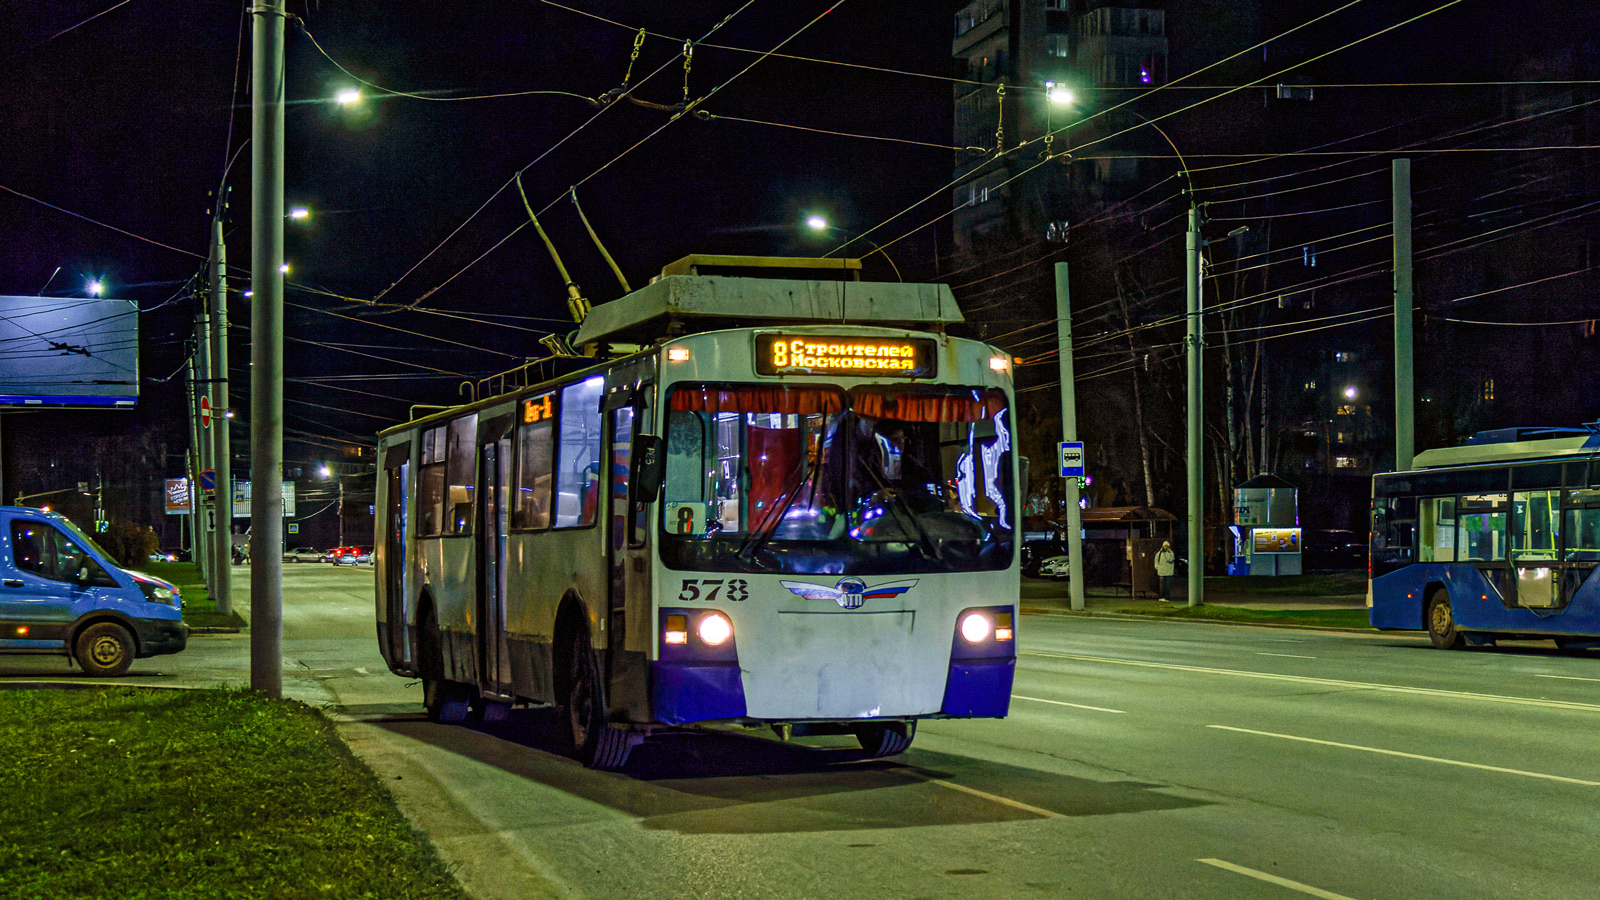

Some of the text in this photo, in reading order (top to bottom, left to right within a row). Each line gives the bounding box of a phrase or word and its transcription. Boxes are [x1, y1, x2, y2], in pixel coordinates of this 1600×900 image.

[773, 340, 787, 367] 8
[790, 340, 914, 358] Строителей
[791, 354, 914, 370] Московская
[677, 506, 694, 535] 8
[678, 578, 749, 602] 578
